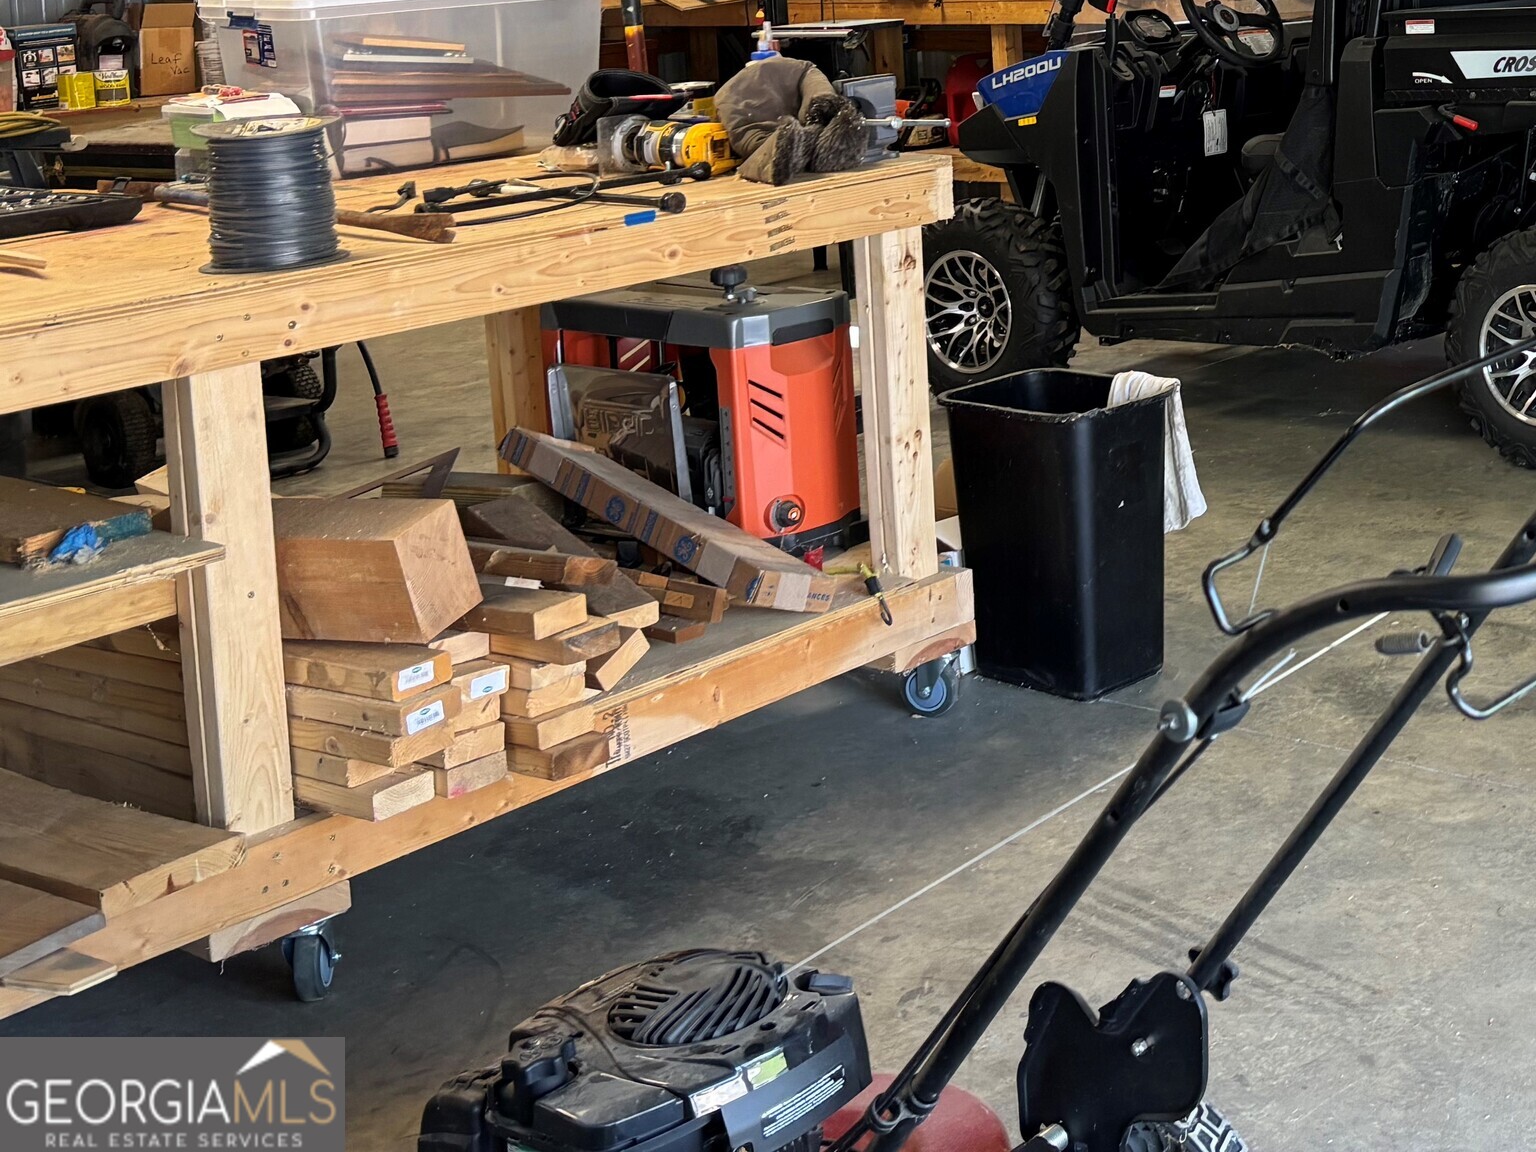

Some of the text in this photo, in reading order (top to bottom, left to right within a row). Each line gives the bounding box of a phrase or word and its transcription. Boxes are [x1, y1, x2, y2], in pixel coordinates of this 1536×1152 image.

[151, 52, 182, 65] Leaf
[170, 65, 190, 75] Vac
[991, 56, 1062, 90] LH200U
[806, 591, 830, 602] ANCES
